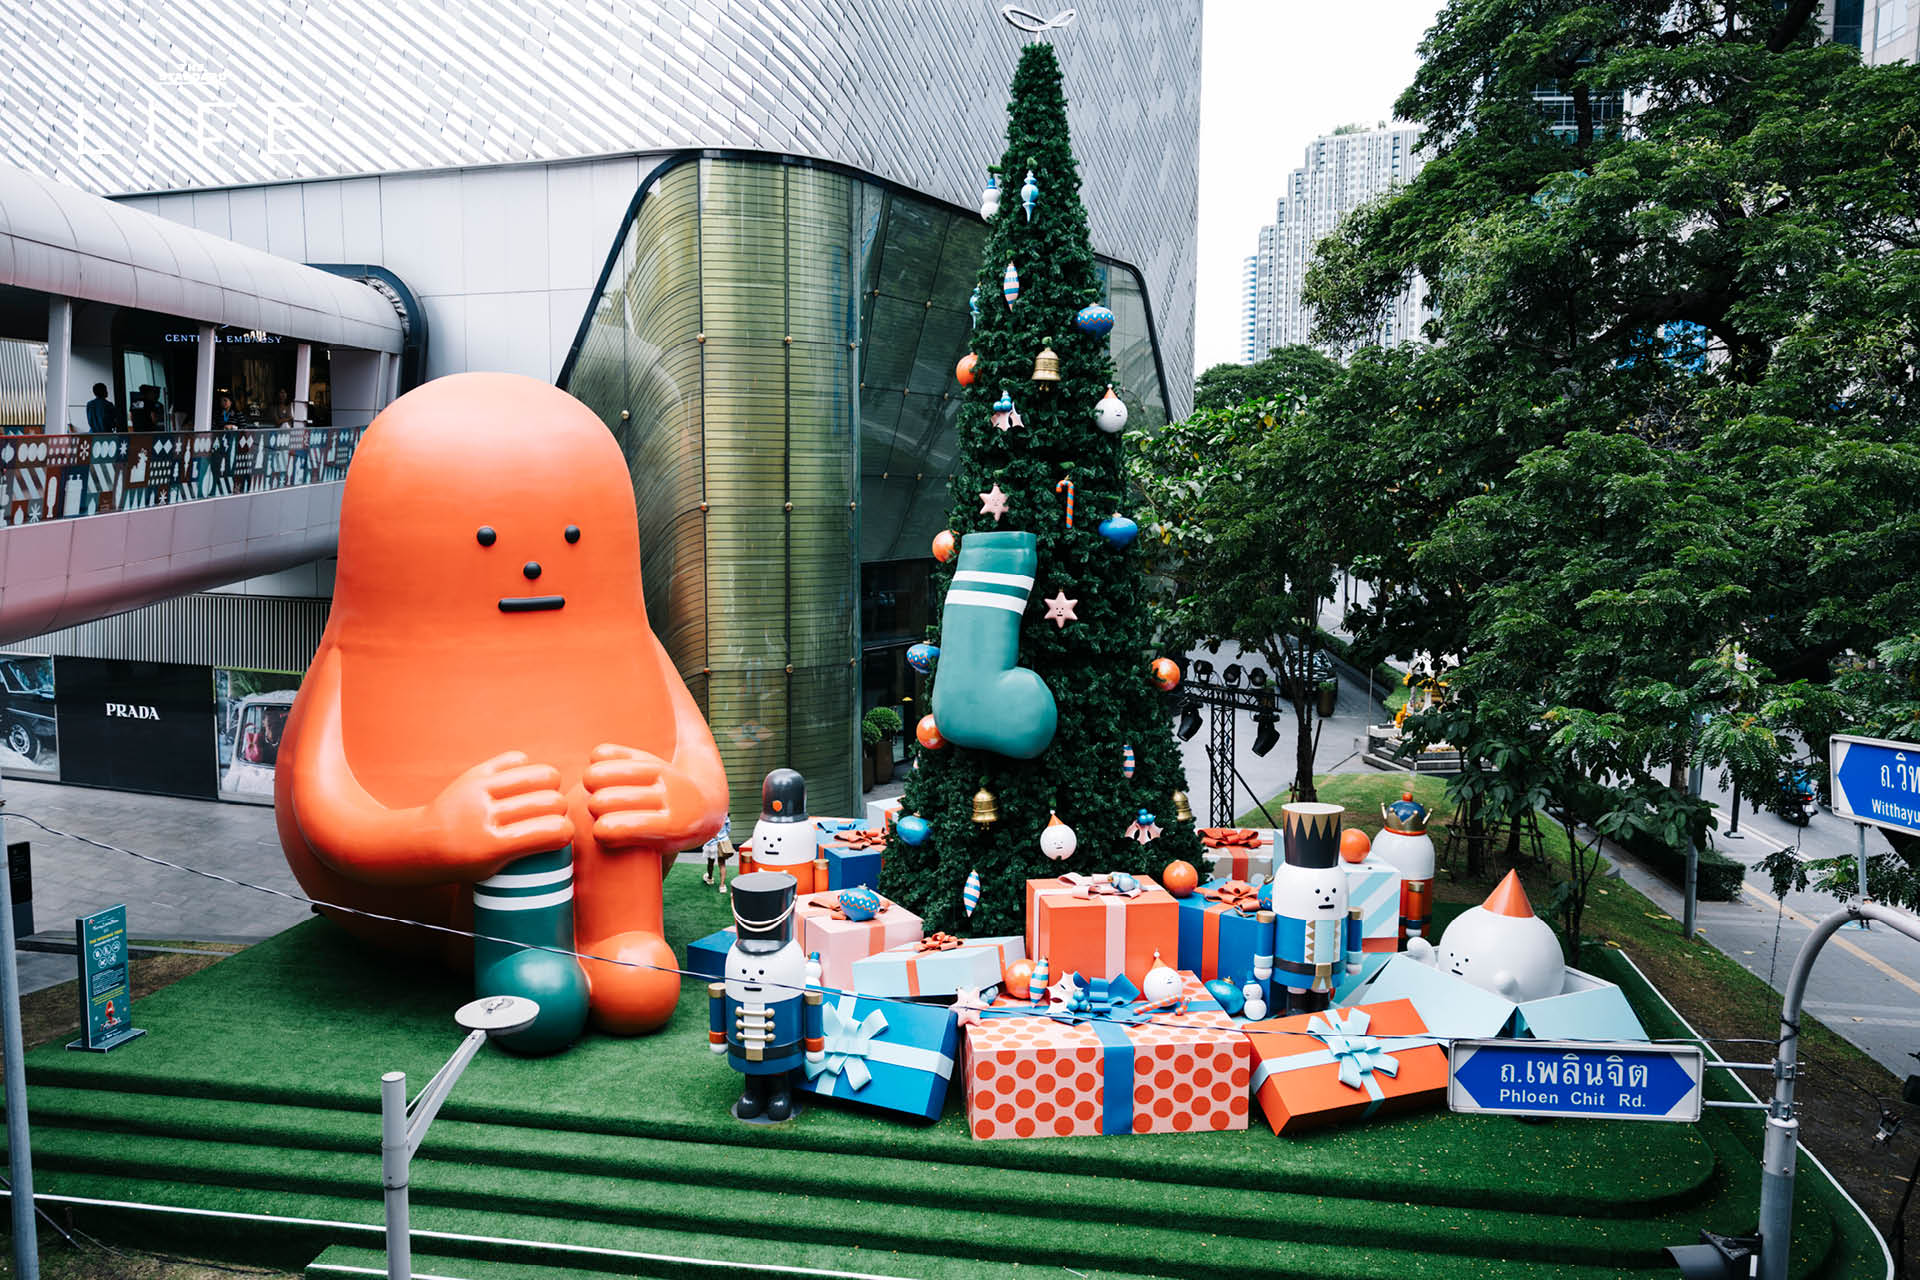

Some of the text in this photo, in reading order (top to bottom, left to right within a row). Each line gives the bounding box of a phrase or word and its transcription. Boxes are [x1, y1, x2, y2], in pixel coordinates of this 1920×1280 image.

[165, 334, 222, 343] CENTL
[105, 702, 160, 720] PRADA
[1500, 1053, 1648, 1088] ถ.เพลินจิต
[1500, 1088, 1646, 1107] Phloen Chit Rd.
